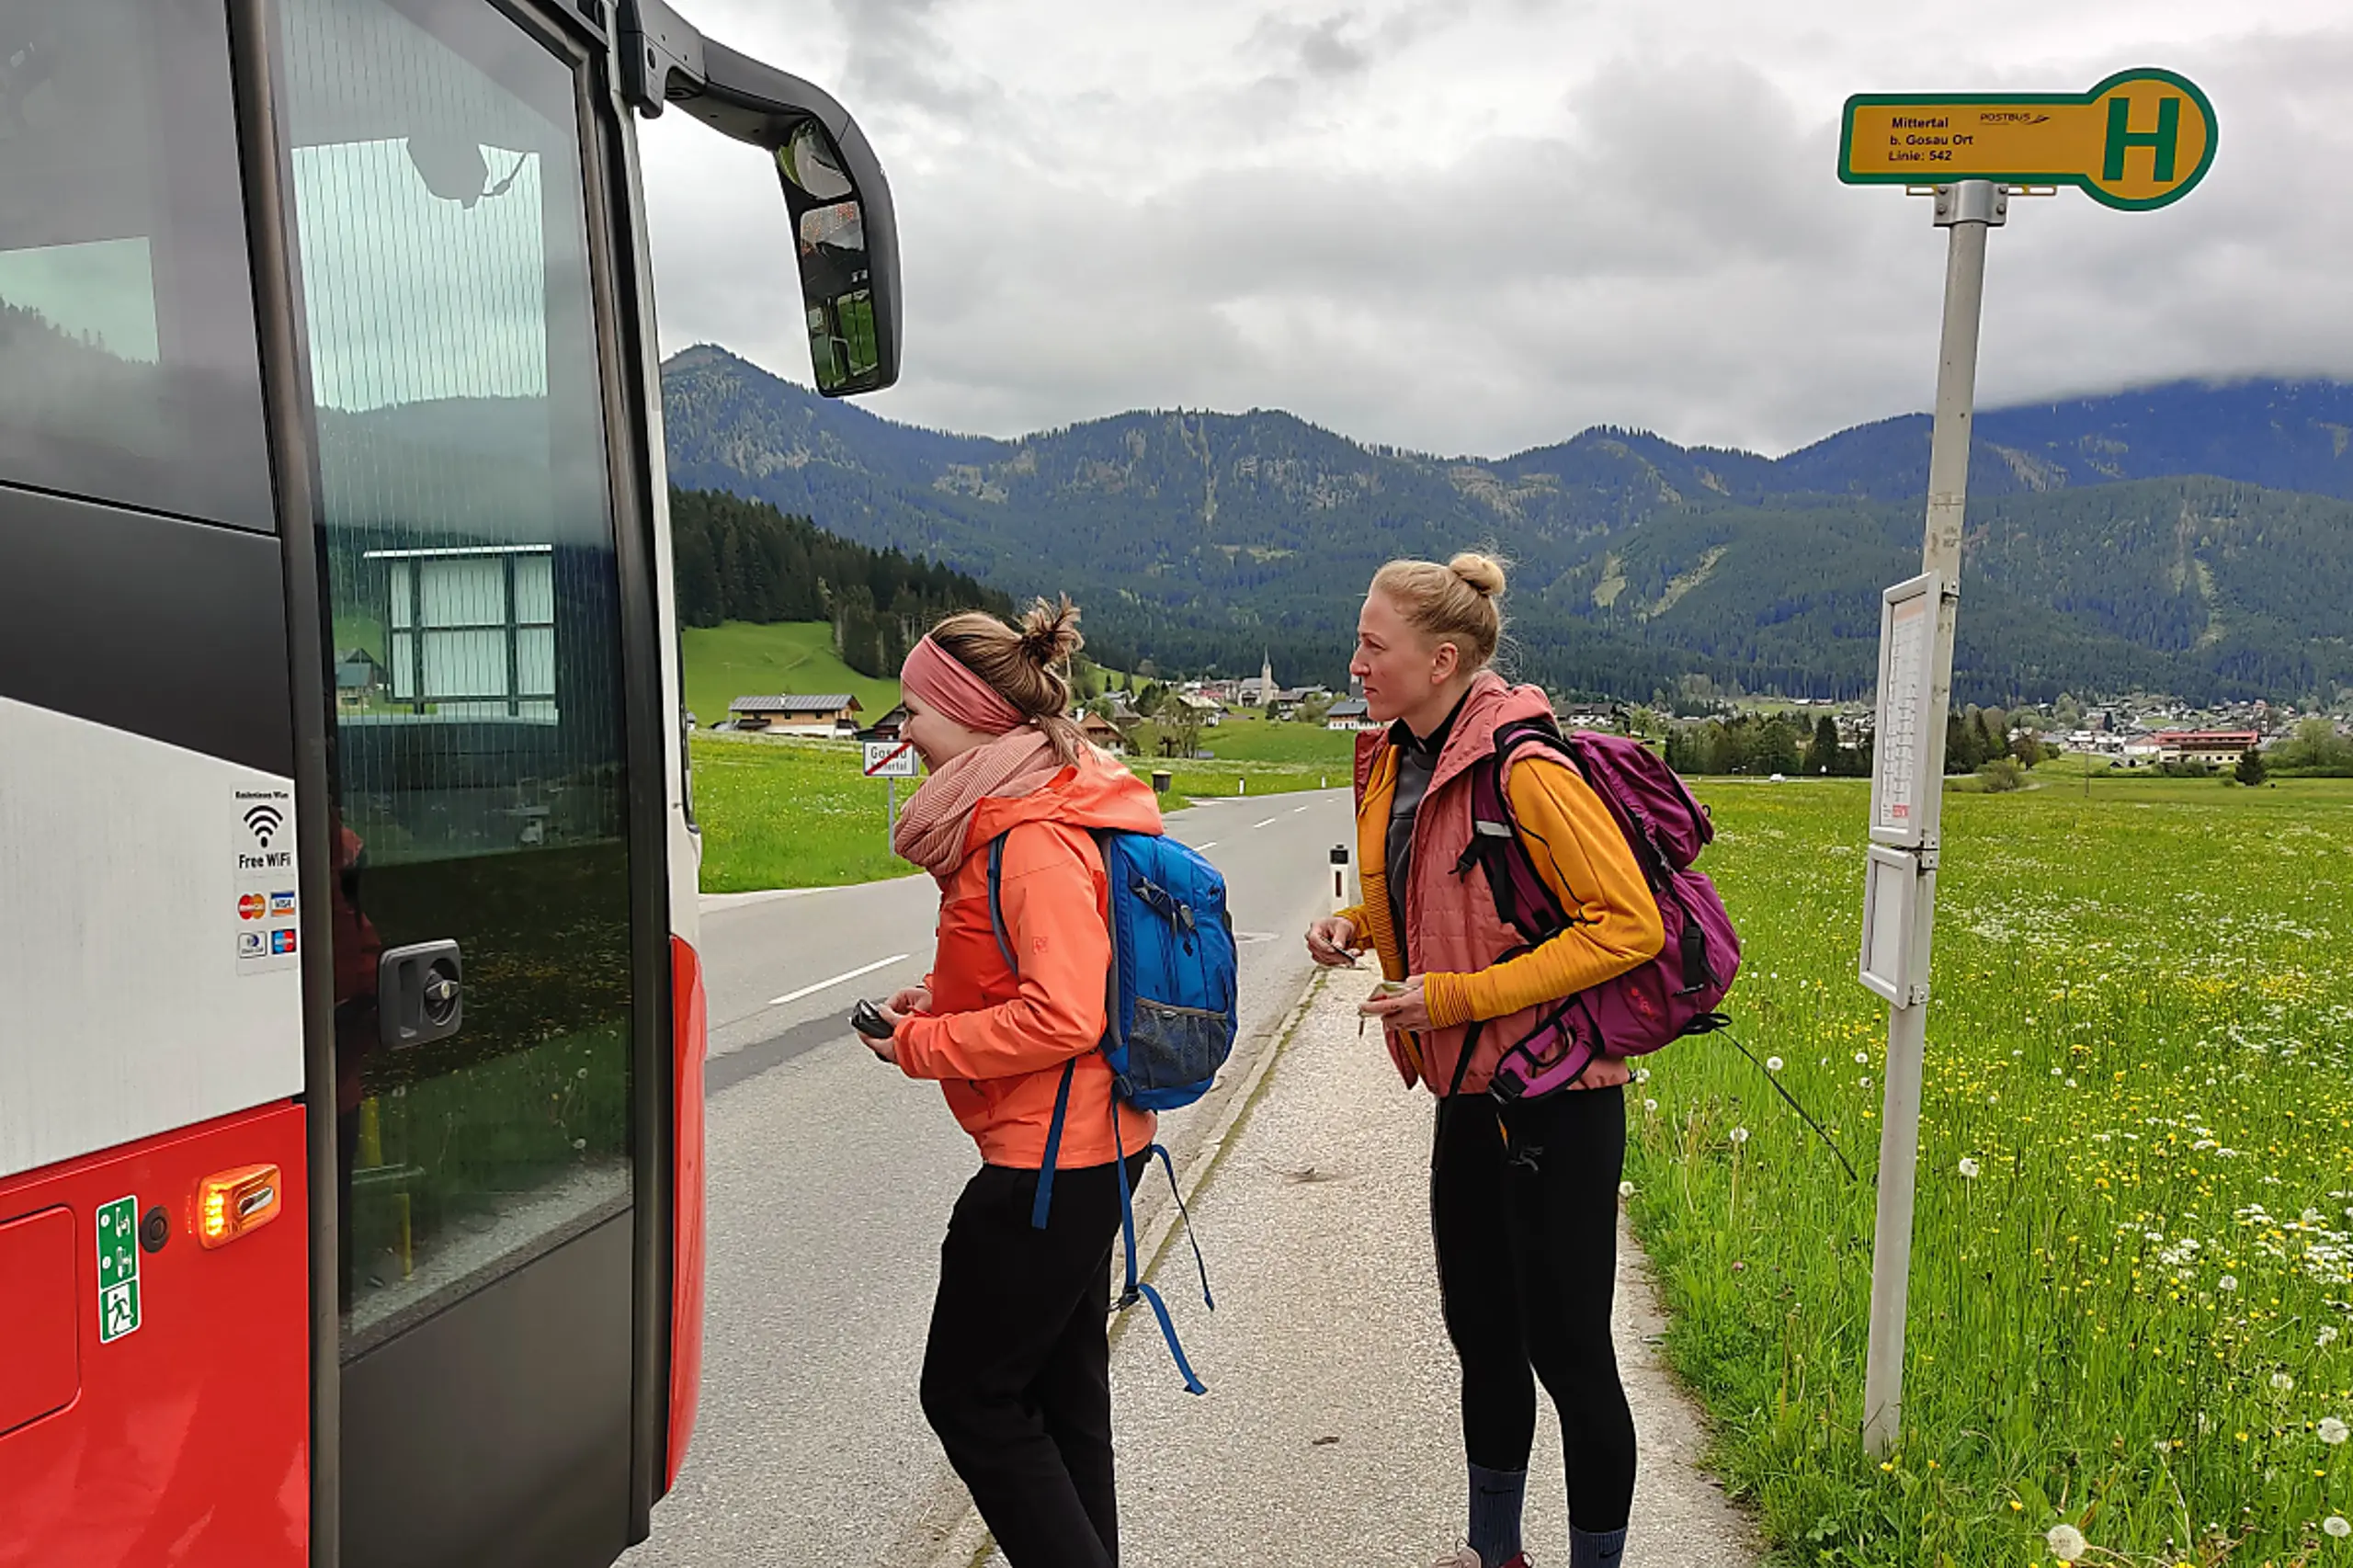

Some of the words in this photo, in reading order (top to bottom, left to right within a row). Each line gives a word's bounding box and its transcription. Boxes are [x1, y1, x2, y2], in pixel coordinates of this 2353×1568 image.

[1891, 116, 1949, 130] Mittertal
[1980, 112, 2031, 122] POSTBUS
[1889, 133, 1902, 146] b.
[1905, 133, 1949, 147] Gosau
[1952, 133, 1974, 146] Ort
[2102, 97, 2180, 182] H
[1887, 149, 1926, 162] Linie:
[1928, 149, 1953, 162] 542
[239, 854, 264, 869] Free
[266, 852, 291, 867] WiFi
